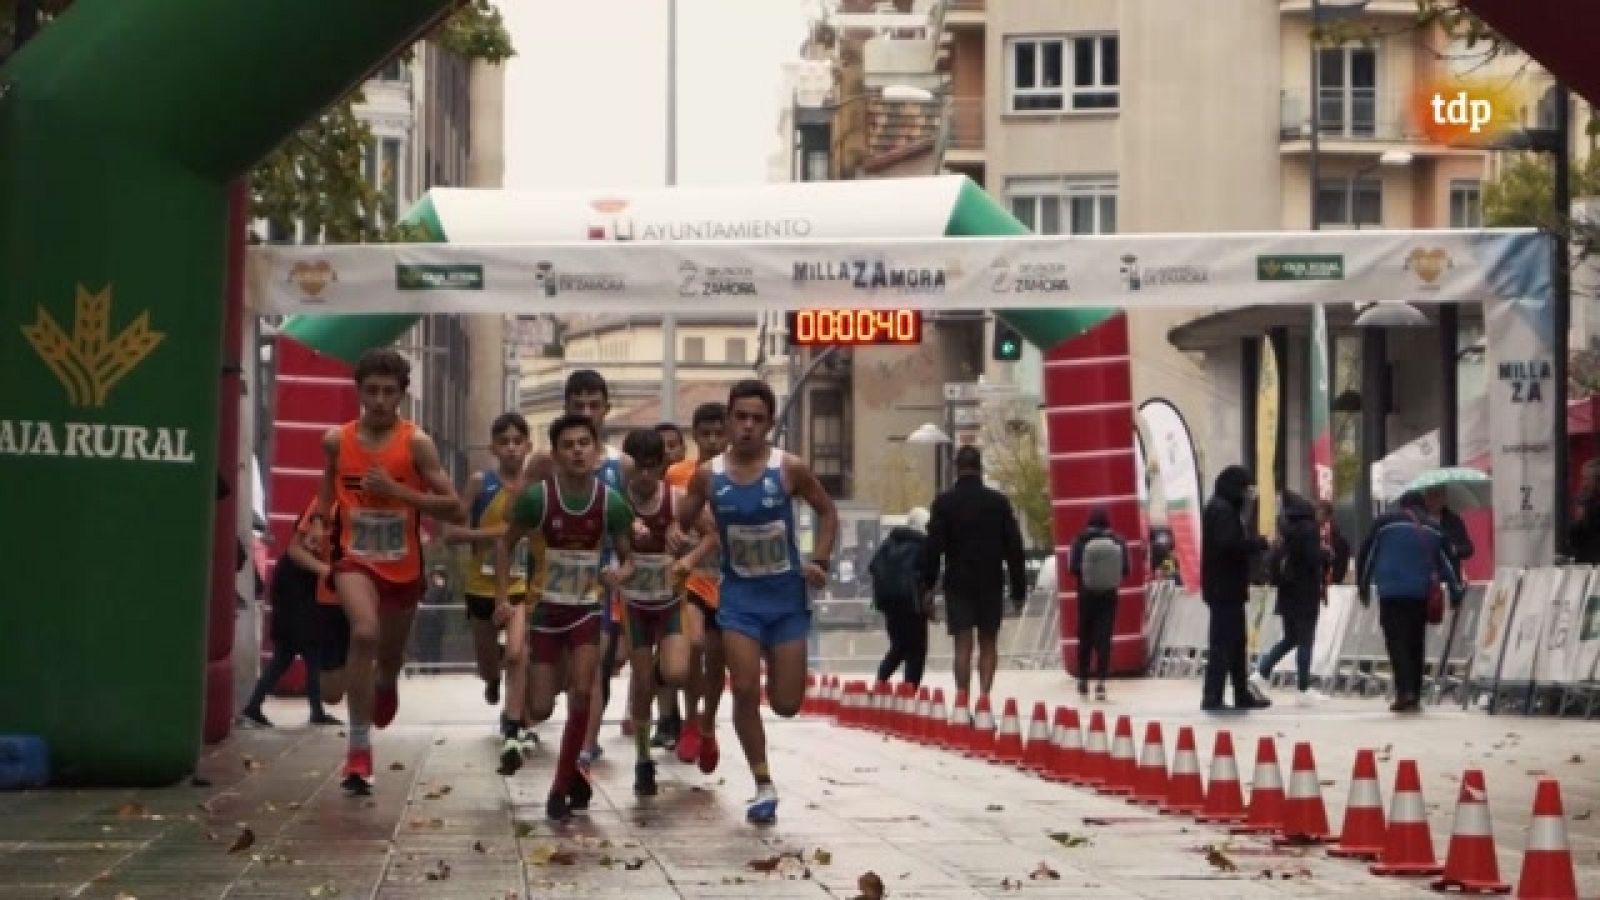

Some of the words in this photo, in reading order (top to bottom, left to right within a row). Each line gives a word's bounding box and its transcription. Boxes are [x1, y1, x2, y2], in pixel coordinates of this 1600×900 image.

[641, 216, 812, 240] AYUNTAMIENTO
[1499, 360, 1551, 379] MILLA
[1512, 381, 1542, 403] ZA
[0, 419, 60, 456] AJA
[63, 421, 196, 463] RURAL
[353, 517, 405, 551] 218
[731, 534, 788, 567] 210
